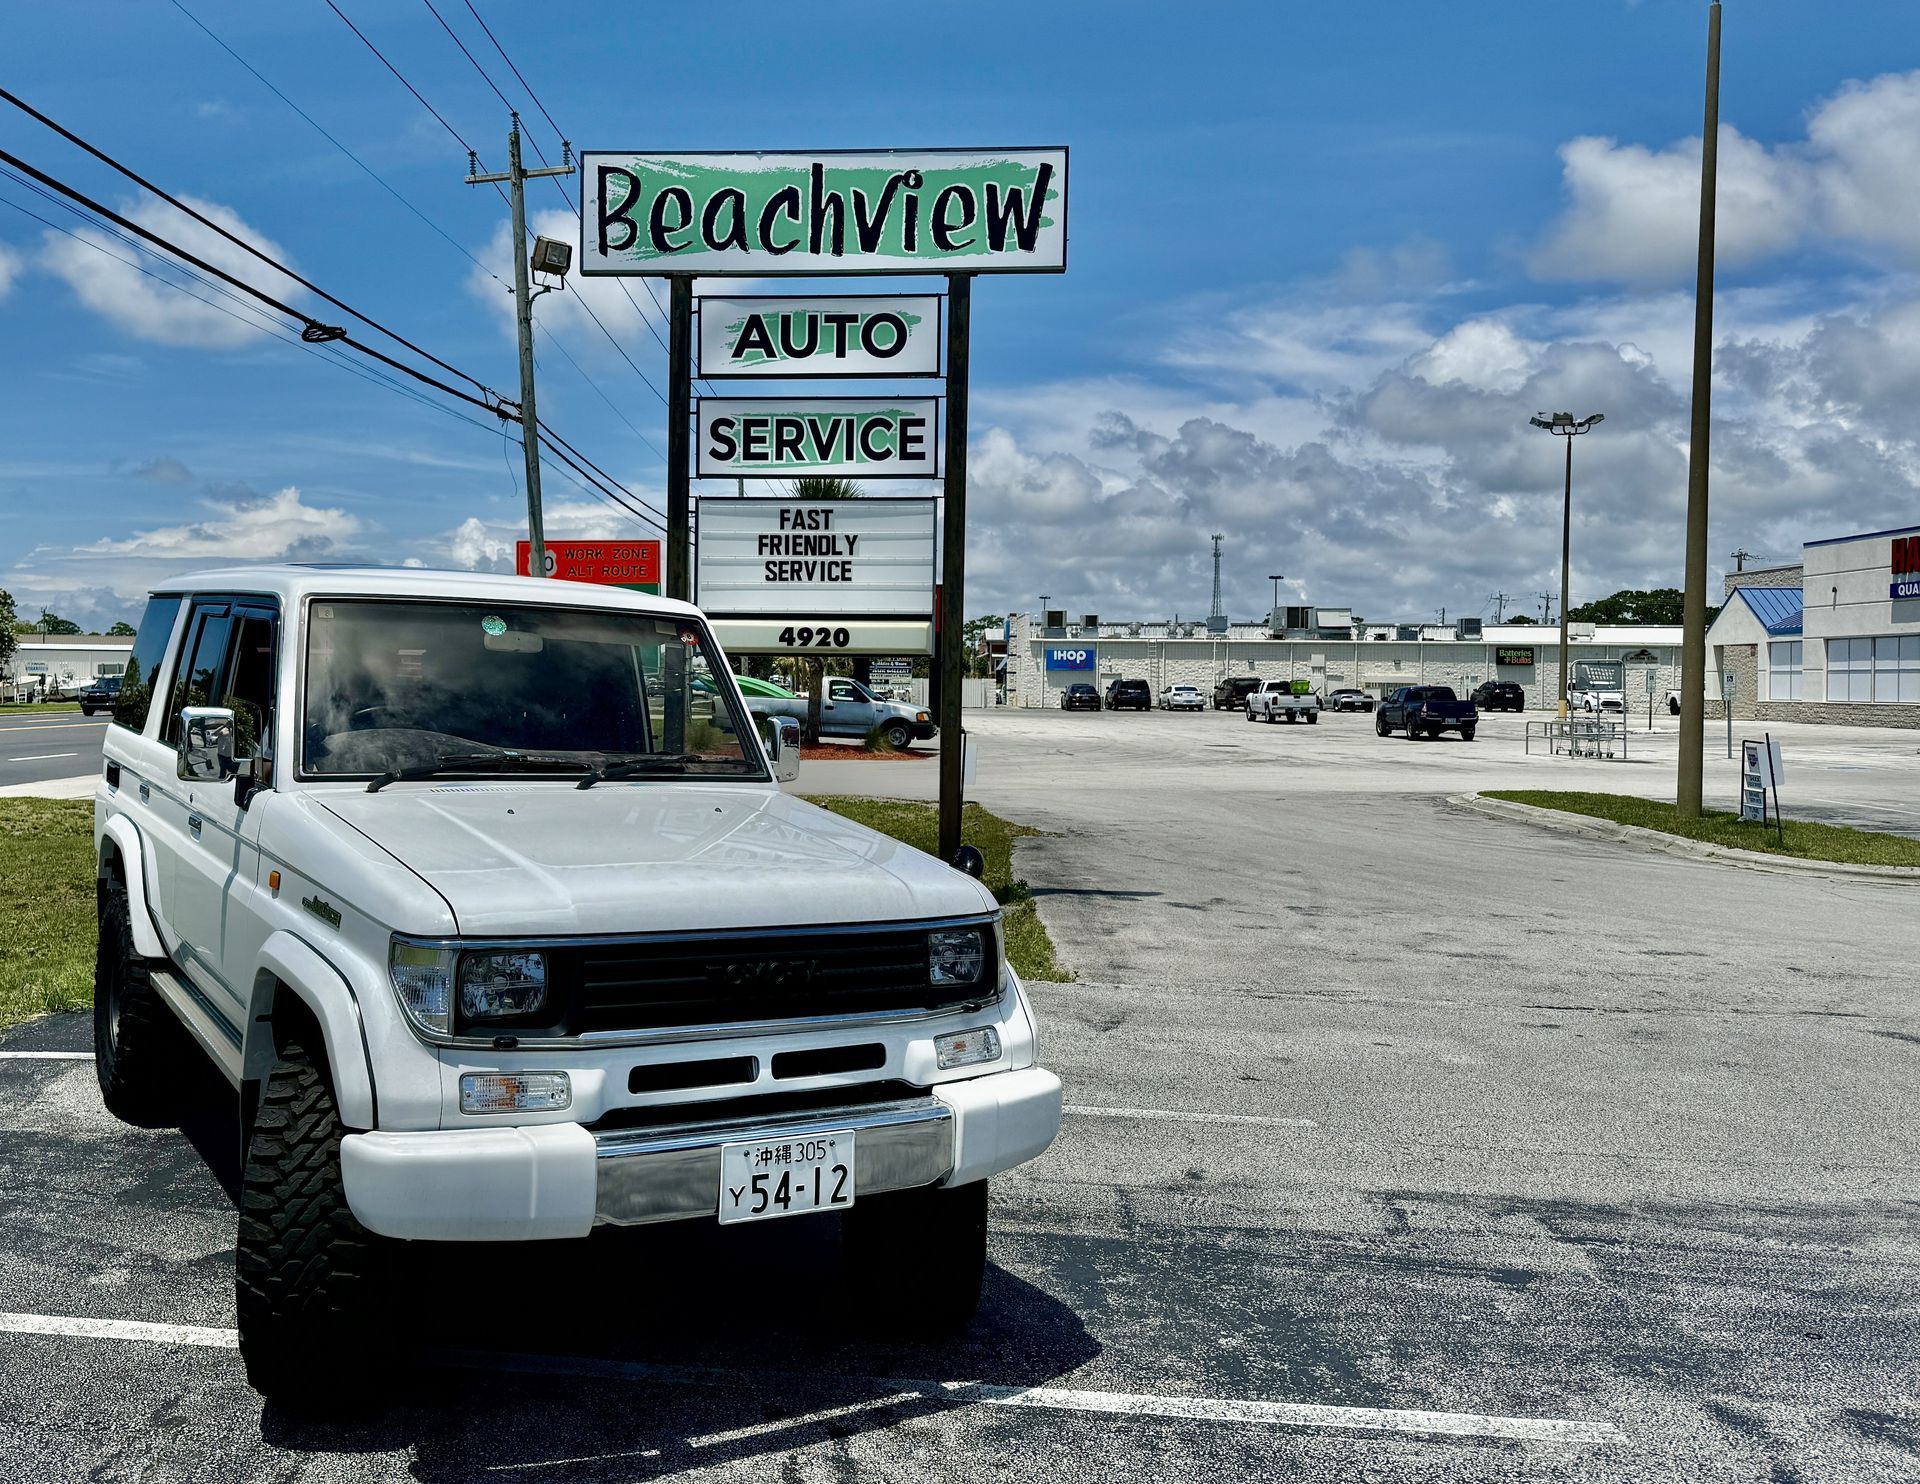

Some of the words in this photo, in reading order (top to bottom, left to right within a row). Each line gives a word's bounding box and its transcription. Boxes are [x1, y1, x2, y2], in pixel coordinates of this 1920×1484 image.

[597, 162, 1053, 258] Beachview
[731, 312, 908, 359] AUTO
[708, 417, 926, 462] SERVICE
[779, 509, 834, 530] FAST
[565, 549, 605, 560] WORK
[613, 548, 650, 560] ZONE
[758, 534, 858, 556] FRIENDLY
[567, 565, 594, 577] ALT
[602, 565, 648, 577] ROUTE
[765, 560, 853, 582] SERVICE
[1898, 583, 1920, 596] QUA
[778, 626, 850, 648] 4920
[1499, 649, 1532, 657] Batteries
[754, 1144, 792, 1167] 沖縄
[794, 1140, 827, 1163] 305
[728, 1185, 746, 1207] Y
[750, 1163, 848, 1214] 54-12
